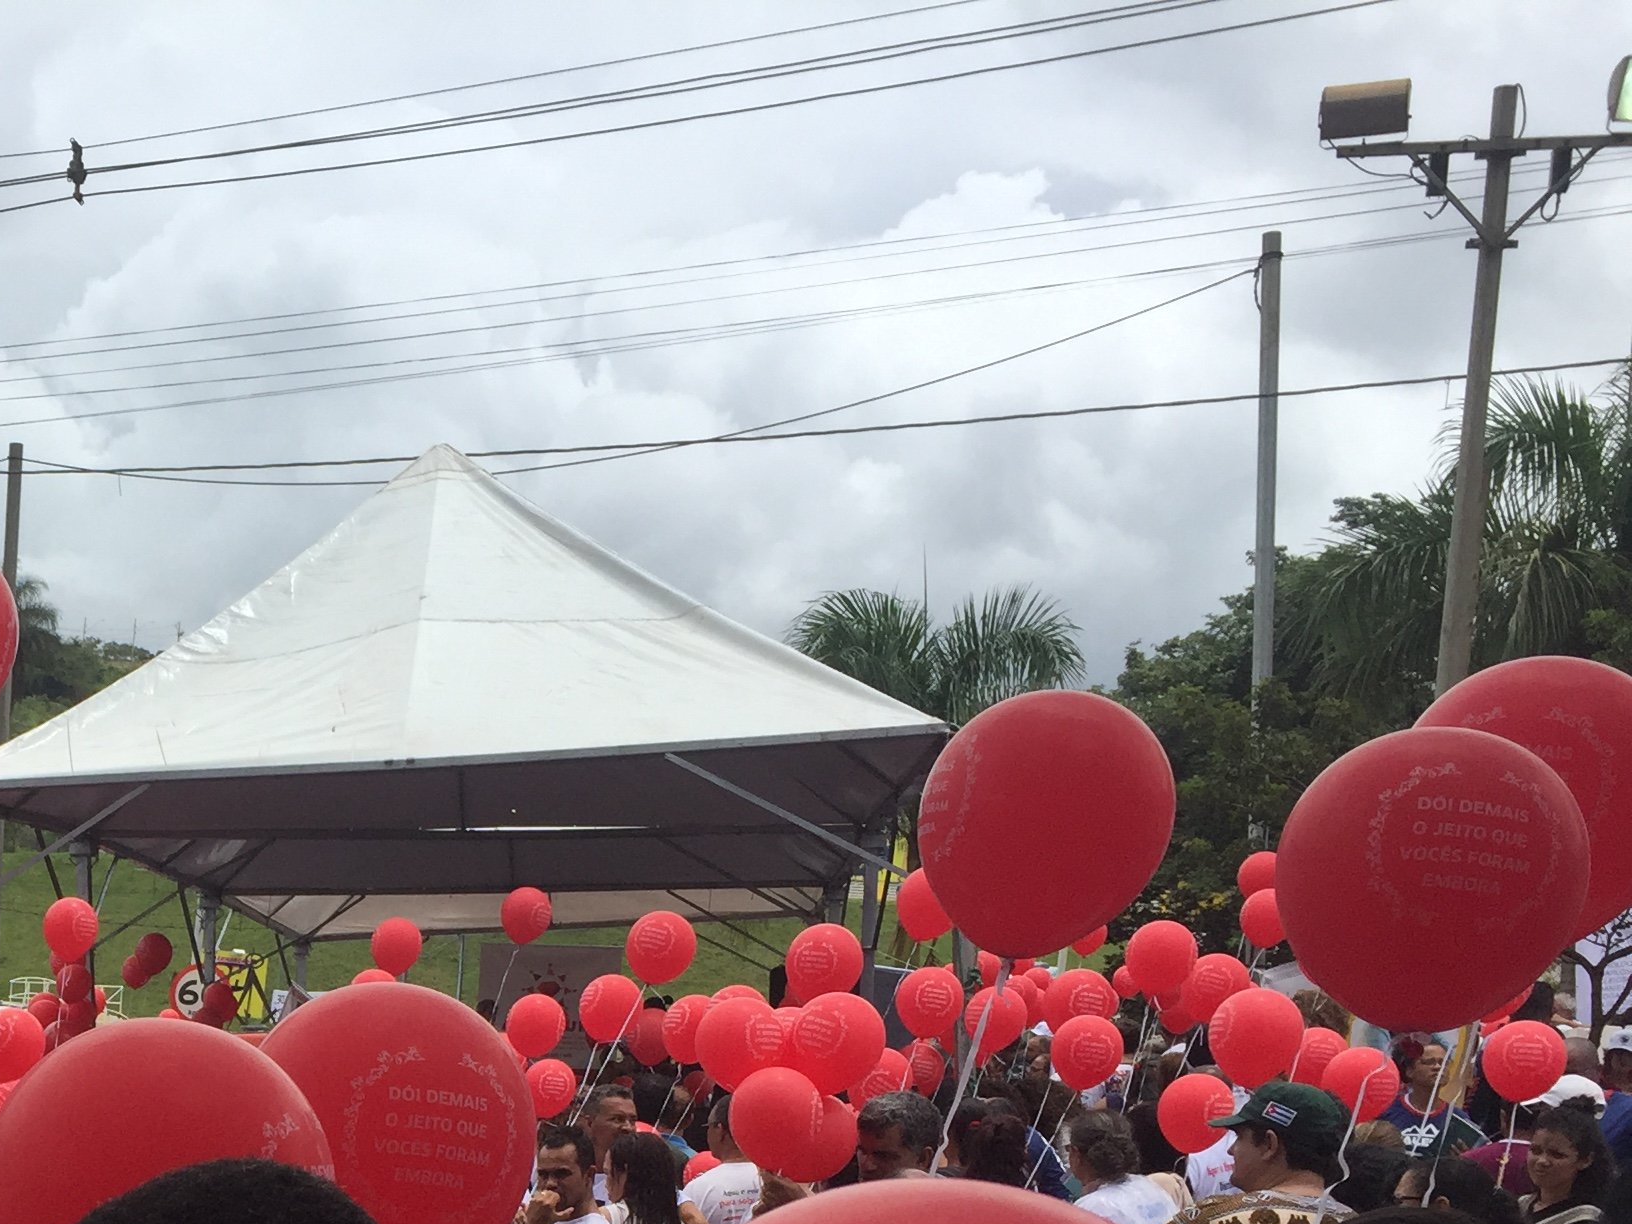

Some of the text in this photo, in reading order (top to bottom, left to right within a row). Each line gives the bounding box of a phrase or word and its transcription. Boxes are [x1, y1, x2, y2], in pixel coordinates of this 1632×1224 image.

[1459, 800, 1530, 823] DEMAIS
[1413, 821, 1528, 849] O JEITO QUE
[1468, 850, 1530, 874] FORAM
[389, 1085, 488, 1112] DÓI DEMAIS
[386, 1112, 488, 1138] O JEITO QUE
[435, 1143, 491, 1166] FORAM
